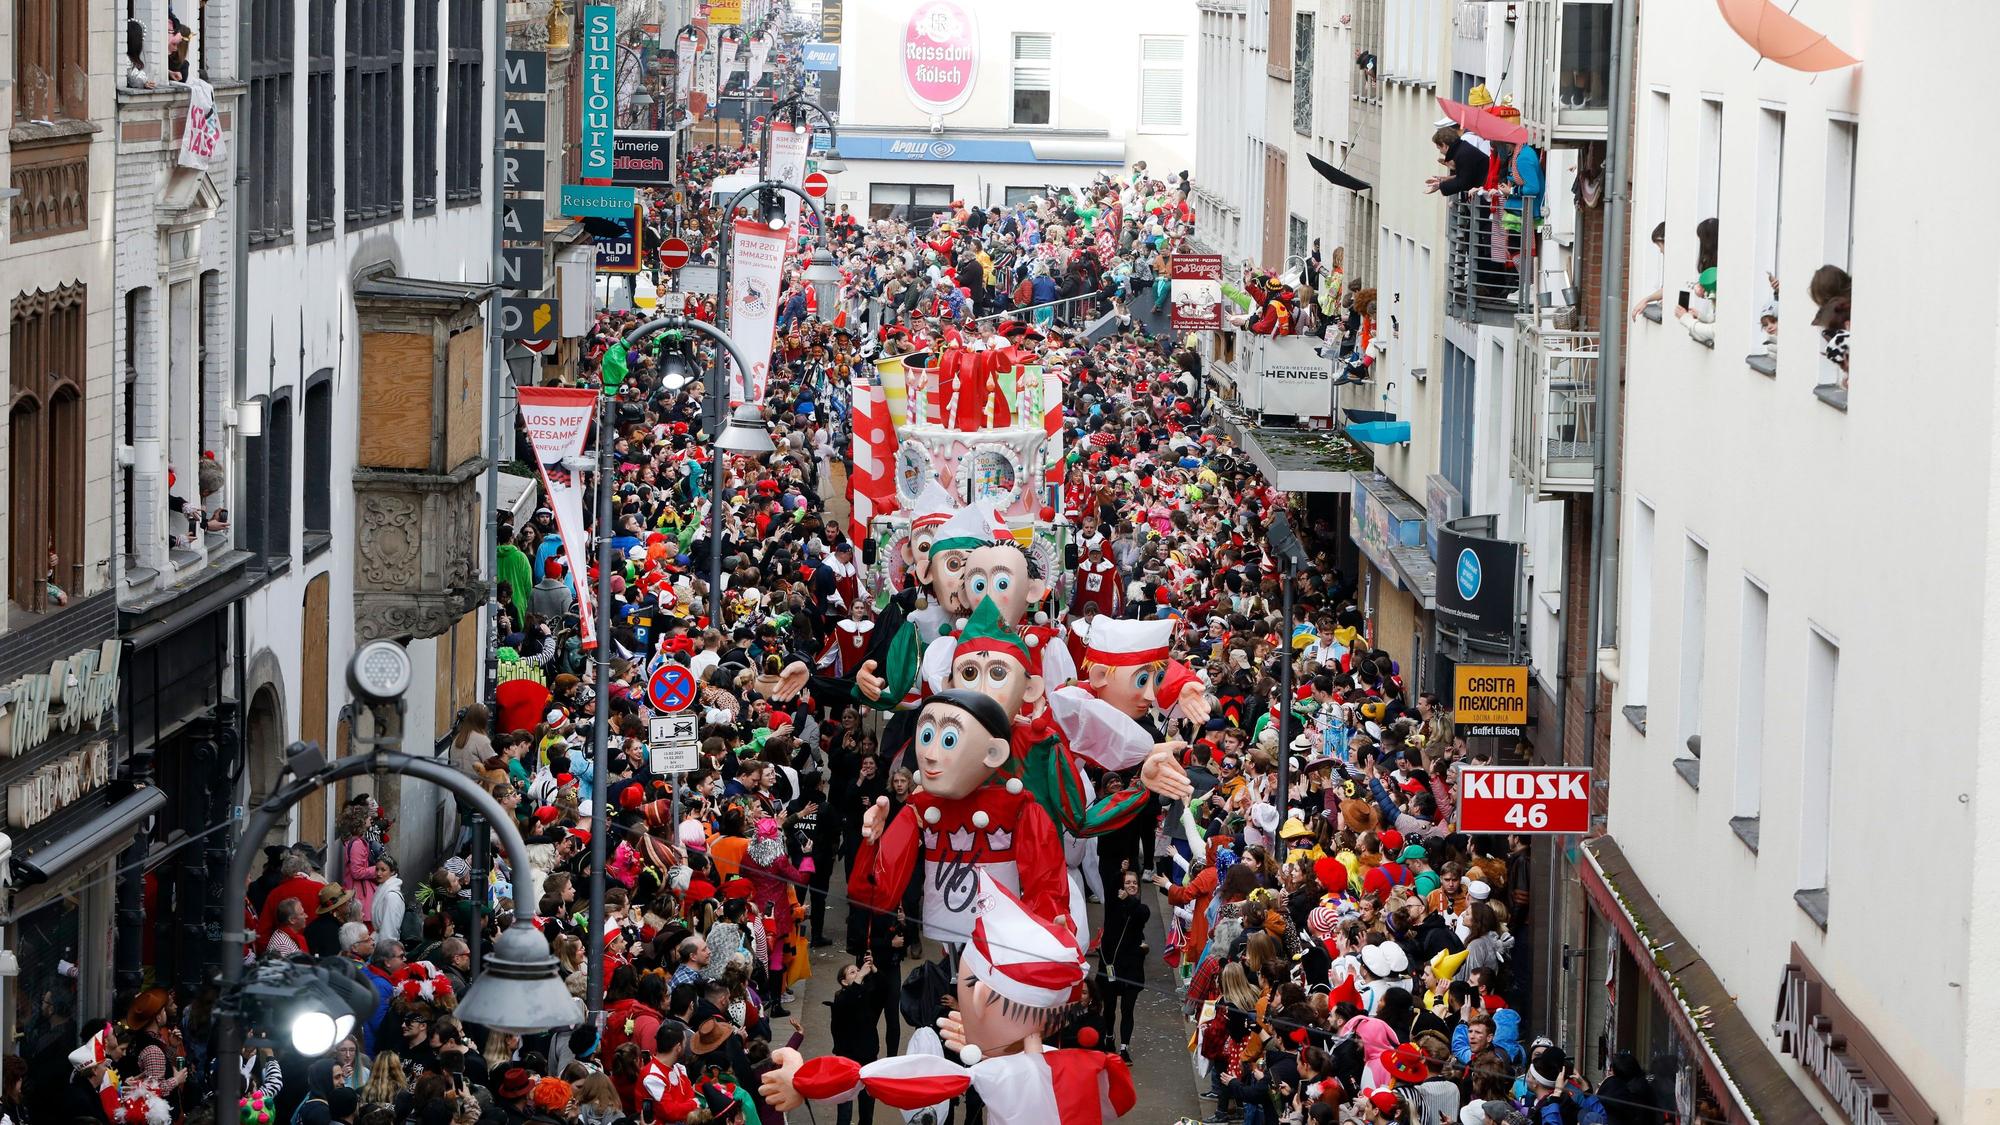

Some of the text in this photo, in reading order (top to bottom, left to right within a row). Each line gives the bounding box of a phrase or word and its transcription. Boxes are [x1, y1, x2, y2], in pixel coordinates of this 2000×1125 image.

[916, 64, 961, 85] Kölsch
[890, 140, 928, 153] APOLLO
[563, 194, 632, 209] Reisebüro
[596, 243, 632, 255] ALDI
[1265, 370, 1328, 379] HENNES
[527, 415, 556, 426] LOSS
[637, 628, 646, 640] P
[1468, 677, 1515, 693] CASITA
[1459, 695, 1524, 712] MEXICANA
[1472, 725, 1520, 737] Gaffel Kölsch
[1464, 773, 1587, 800] KIOSK
[1504, 803, 1548, 828] 46
[793, 822, 817, 830] SWAT
